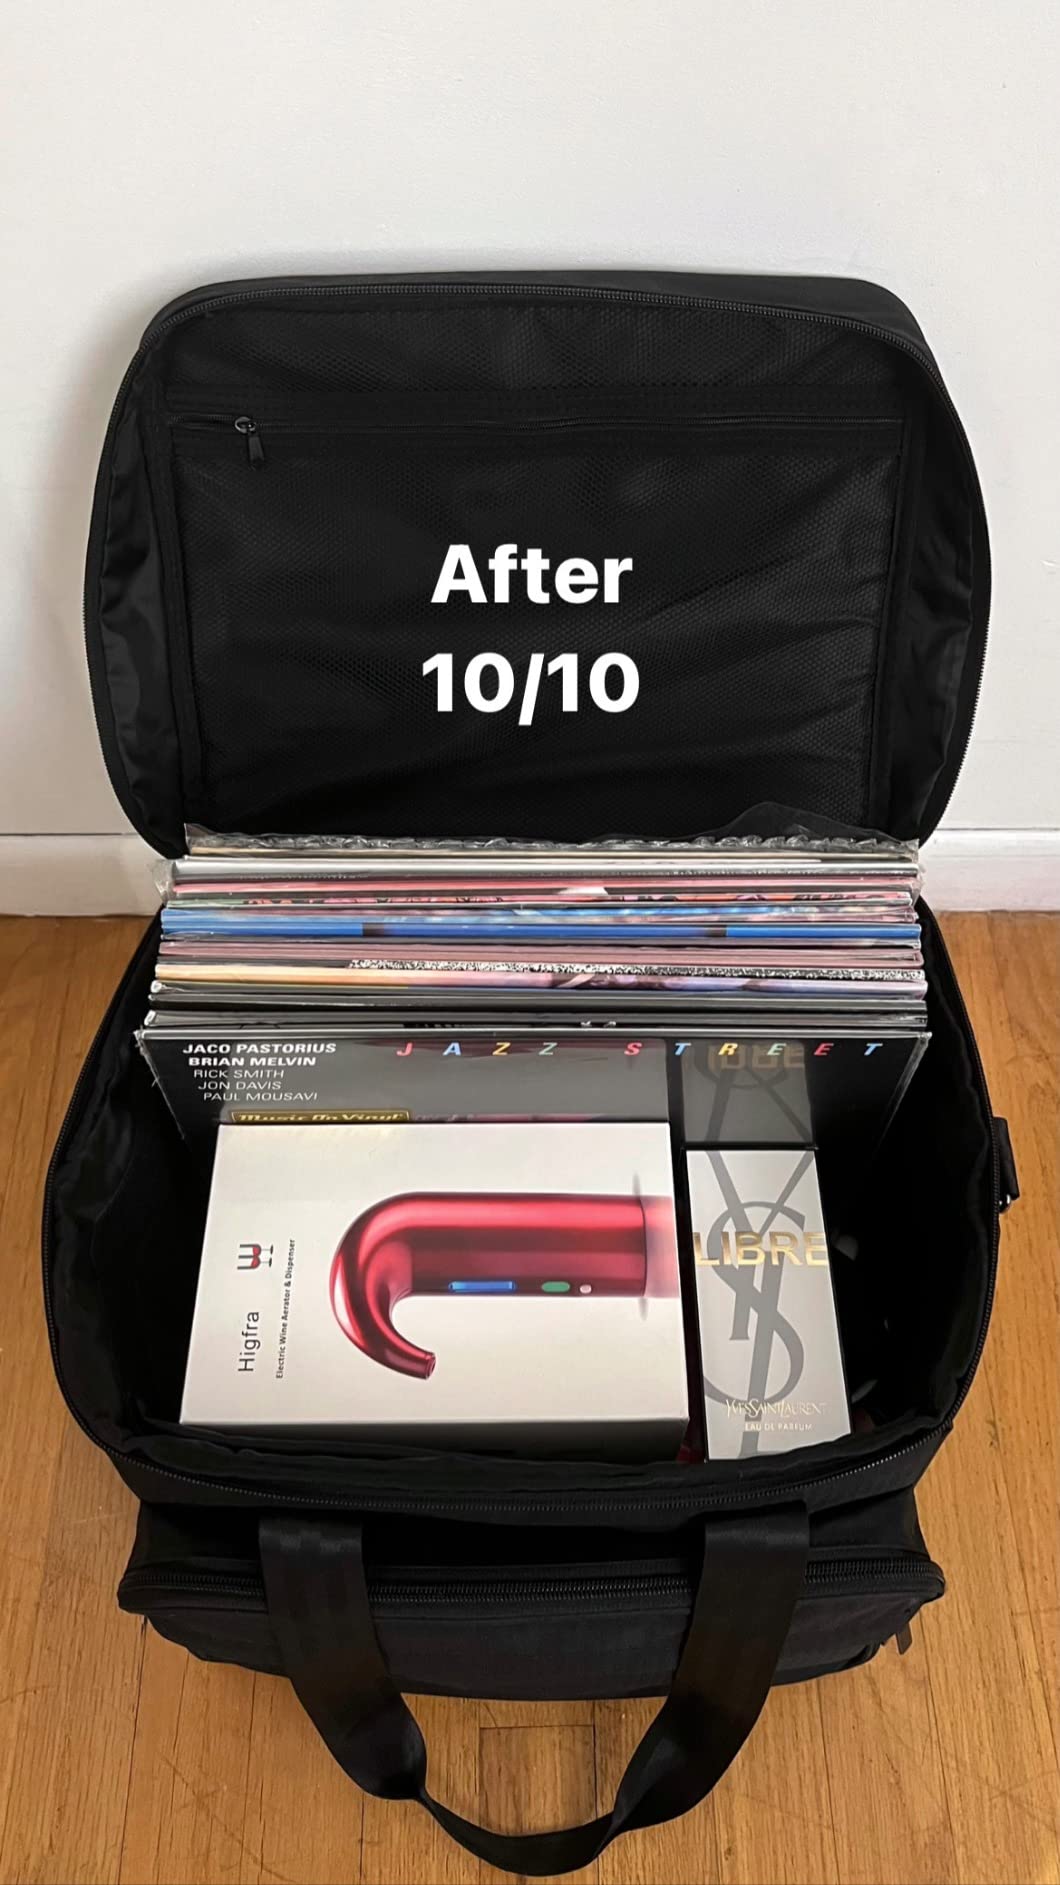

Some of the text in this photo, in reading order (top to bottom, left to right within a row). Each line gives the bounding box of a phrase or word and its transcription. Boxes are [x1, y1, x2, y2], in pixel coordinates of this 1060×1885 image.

[182, 1043, 337, 1054] JACO PASTORIUS
[396, 1042, 883, 1056] JAZZ STREET
[188, 1056, 317, 1066] BRIAN MELVIN
[193, 1069, 285, 1079] RICK SMITH
[198, 1081, 282, 1090] JON DAVIS
[203, 1092, 318, 1101] PAUL MOUSAVI
[312, 1113, 338, 1121] On
[692, 1231, 829, 1266] LIBRE
[276, 1239, 296, 1379] Electric Wine Aerator & Dispenser
[238, 1311, 261, 1372] Higfra
[745, 1423, 761, 1432] EAU
[778, 1423, 813, 1431] PARFUM
